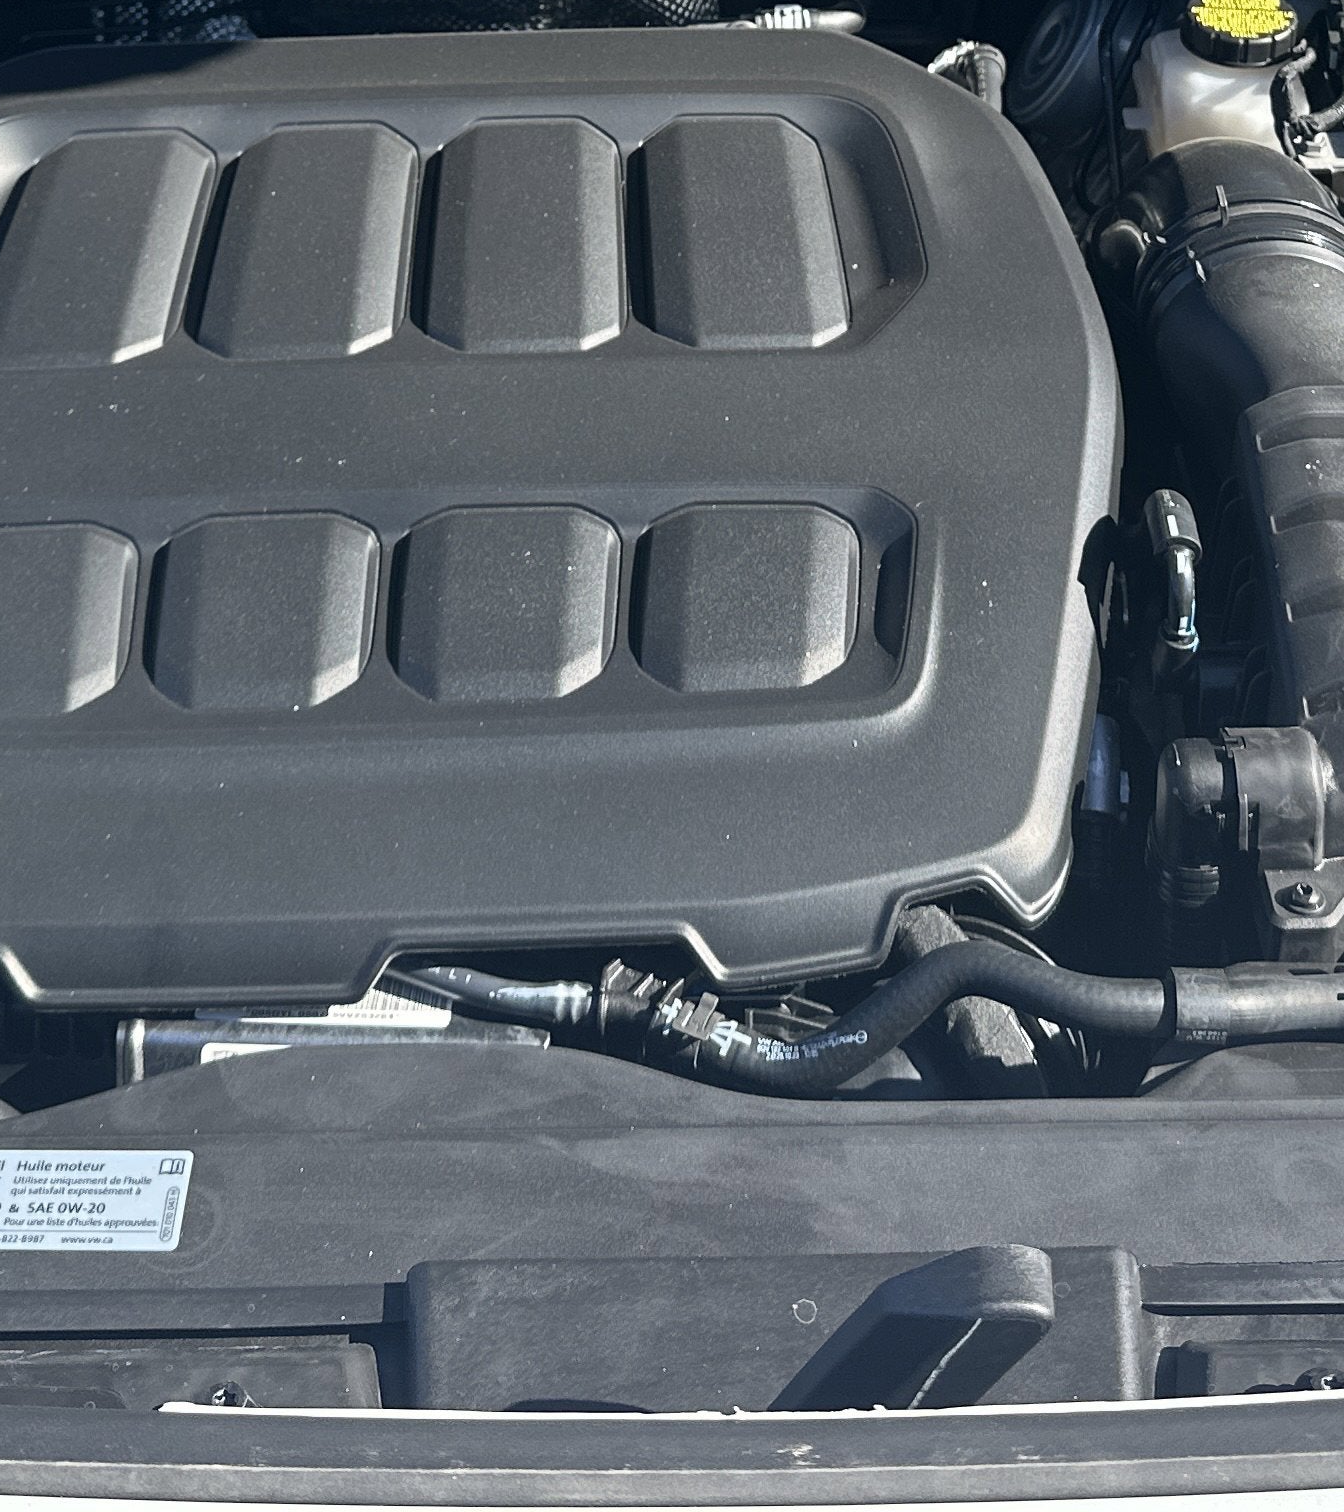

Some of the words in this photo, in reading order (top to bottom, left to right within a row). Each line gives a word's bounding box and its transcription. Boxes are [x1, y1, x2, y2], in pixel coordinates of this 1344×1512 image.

[16, 1160, 53, 1172] Huile
[55, 1161, 106, 1172] moteur
[13, 1176, 48, 1185] Utilisez
[49, 1176, 107, 1187] uniquement
[109, 1176, 122, 1185] de
[10, 1186, 26, 1197] qui
[28, 1186, 65, 1195] satisfait
[8, 1204, 20, 1213] &
[26, 1202, 55, 1214] SAE
[57, 1202, 107, 1214] 0W-20
[3, 1217, 25, 1226] Pour
[26, 1218, 45, 1226] une
[46, 1217, 65, 1226] liste
[60, 1236, 114, 1244] www.vw.ca
